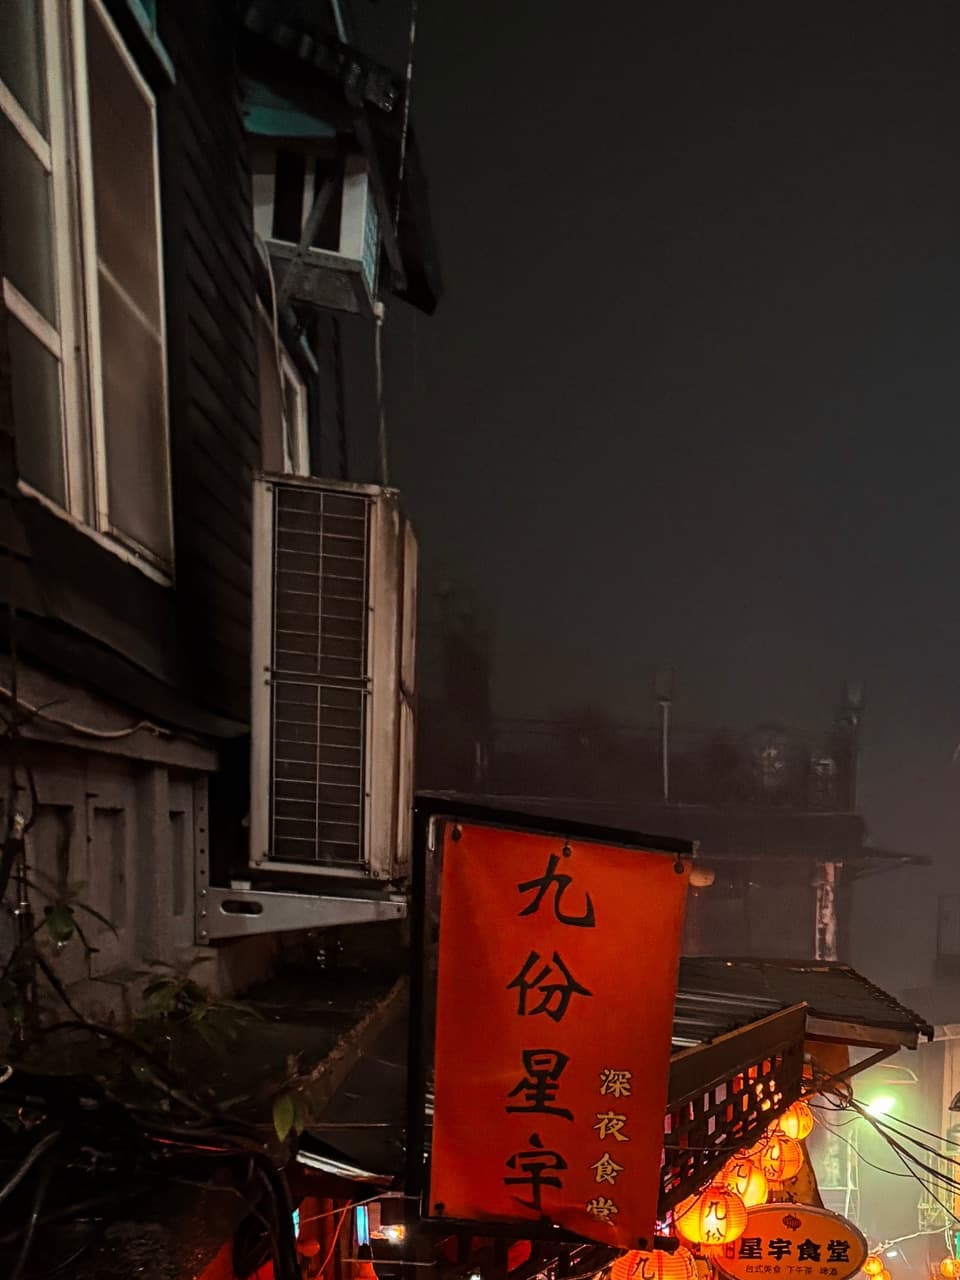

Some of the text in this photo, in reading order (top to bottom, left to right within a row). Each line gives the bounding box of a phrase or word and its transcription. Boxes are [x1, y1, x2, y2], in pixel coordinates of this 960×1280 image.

[504, 853, 596, 1211] 九份星宇
[586, 1067, 633, 1227] 深夜食堂
[705, 1201, 727, 1242] 九份
[739, 1237, 851, 1263] 星宇食堂
